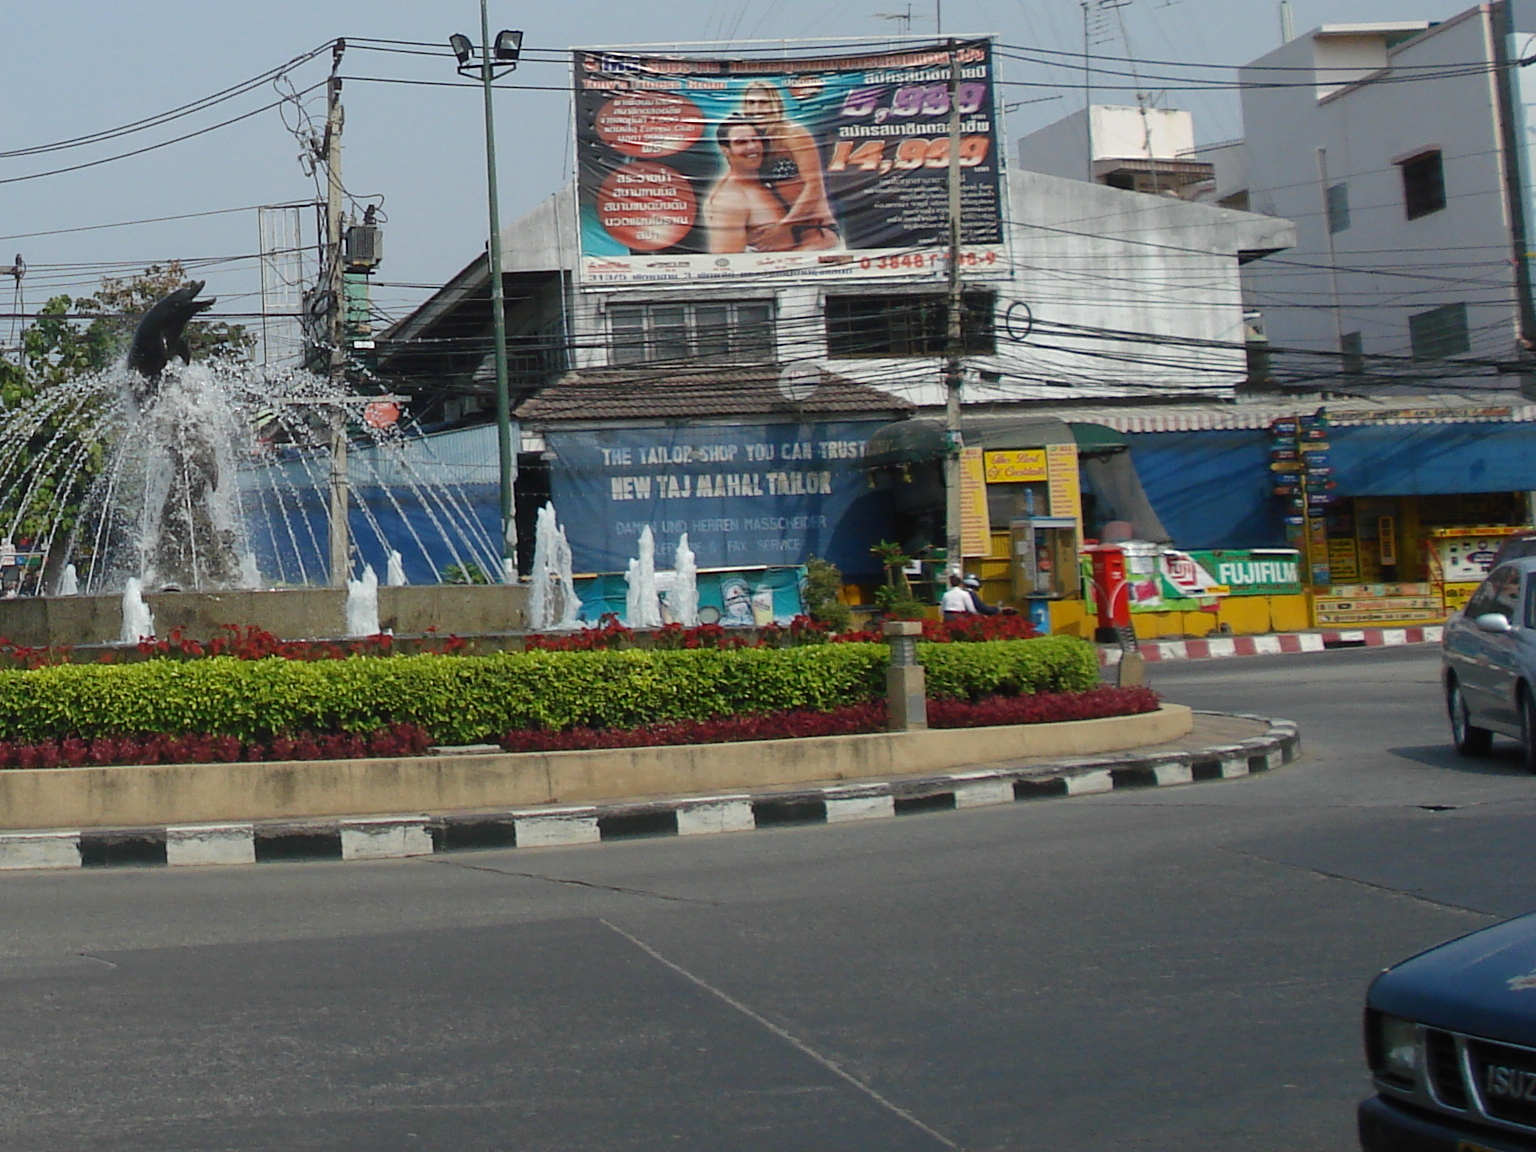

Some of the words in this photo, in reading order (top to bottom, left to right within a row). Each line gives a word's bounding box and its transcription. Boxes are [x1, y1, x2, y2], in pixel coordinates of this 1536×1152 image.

[864, 65, 986, 84] สมัครสมาชิกายปี
[840, 83, 986, 123] 5,999
[828, 135, 990, 175] 14,999
[603, 448, 631, 466] THE
[746, 444, 774, 462] YOU
[781, 443, 812, 461] CAN
[818, 440, 866, 460] TRUST
[611, 476, 651, 500] NEW
[656, 474, 692, 498] TAJ
[696, 472, 763, 498] MAHAL
[766, 470, 832, 496] TAILOR
[663, 519, 687, 533] UND
[694, 518, 740, 533] HERREN
[727, 540, 748, 553] FAX
[756, 538, 801, 552] SERVICE
[1220, 562, 1298, 585] FUJIFILM
